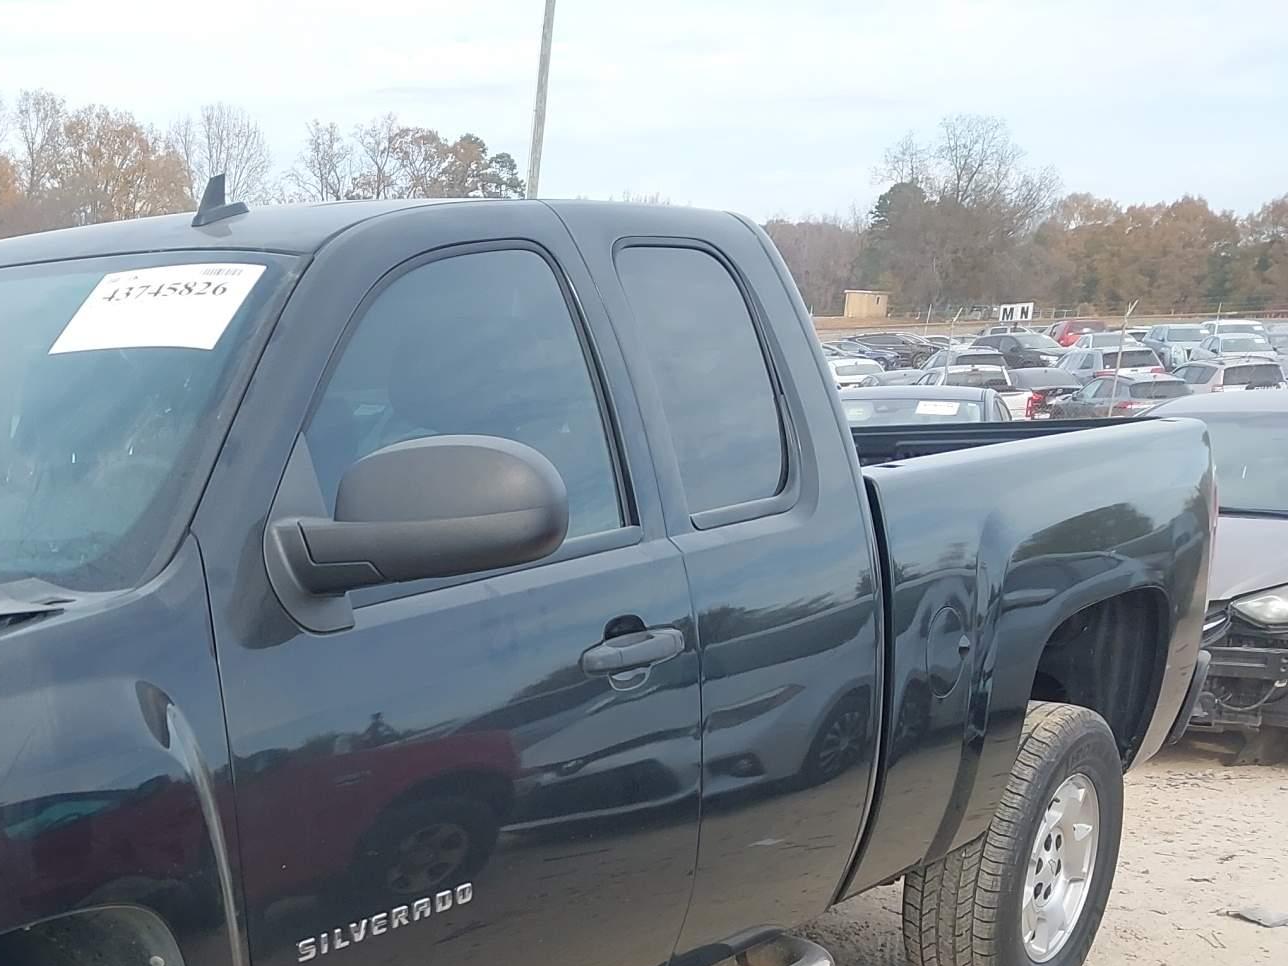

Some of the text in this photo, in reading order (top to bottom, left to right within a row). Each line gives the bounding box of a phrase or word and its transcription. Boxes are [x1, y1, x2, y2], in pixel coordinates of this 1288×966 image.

[103, 281, 229, 302] 43745826
[1002, 305, 1029, 321] M N
[297, 882, 473, 962] SILVERADO
